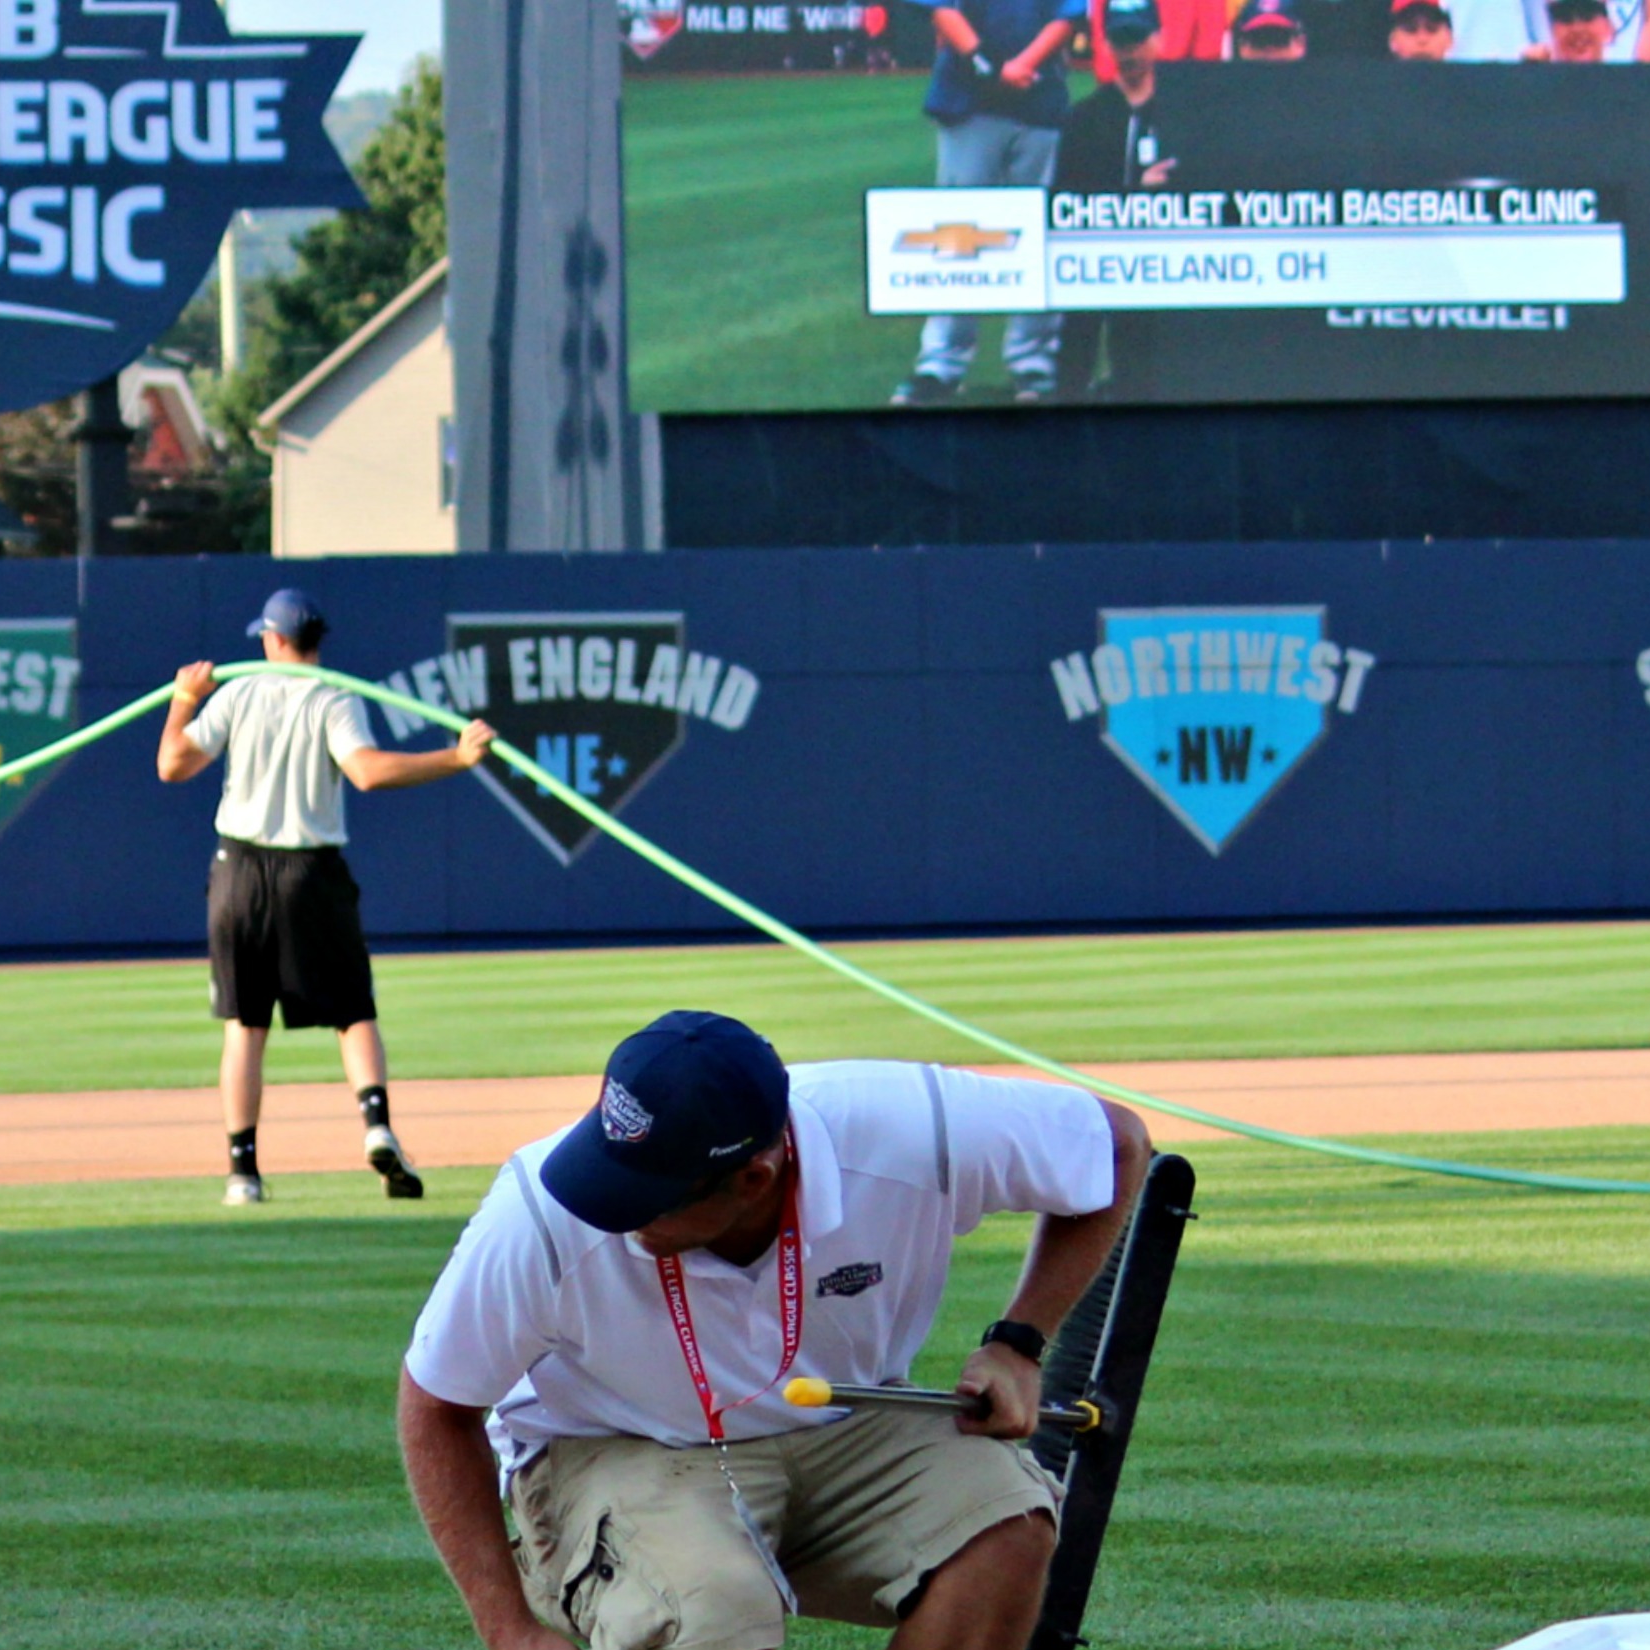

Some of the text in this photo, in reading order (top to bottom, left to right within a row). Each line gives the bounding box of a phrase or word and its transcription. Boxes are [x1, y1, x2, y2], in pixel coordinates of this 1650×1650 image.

[687, 5, 747, 31] MLB
[1052, 188, 1597, 229] CHEVROLET YOUTH BASEBALL CLINIC
[890, 271, 1024, 287] CHEVROLET
[1054, 250, 1327, 286] CLEVELAND, OH
[376, 635, 761, 742] NEW ENGLAND
[1051, 629, 1376, 722] NORTHWEST
[536, 733, 604, 797] NE
[1178, 725, 1254, 785] NW
[784, 1245, 796, 1297] CLASSIC
[666, 1278, 687, 1326] LEAGUE
[680, 1327, 700, 1375] CLASSIC
[786, 1300, 797, 1346] LEAGUE
